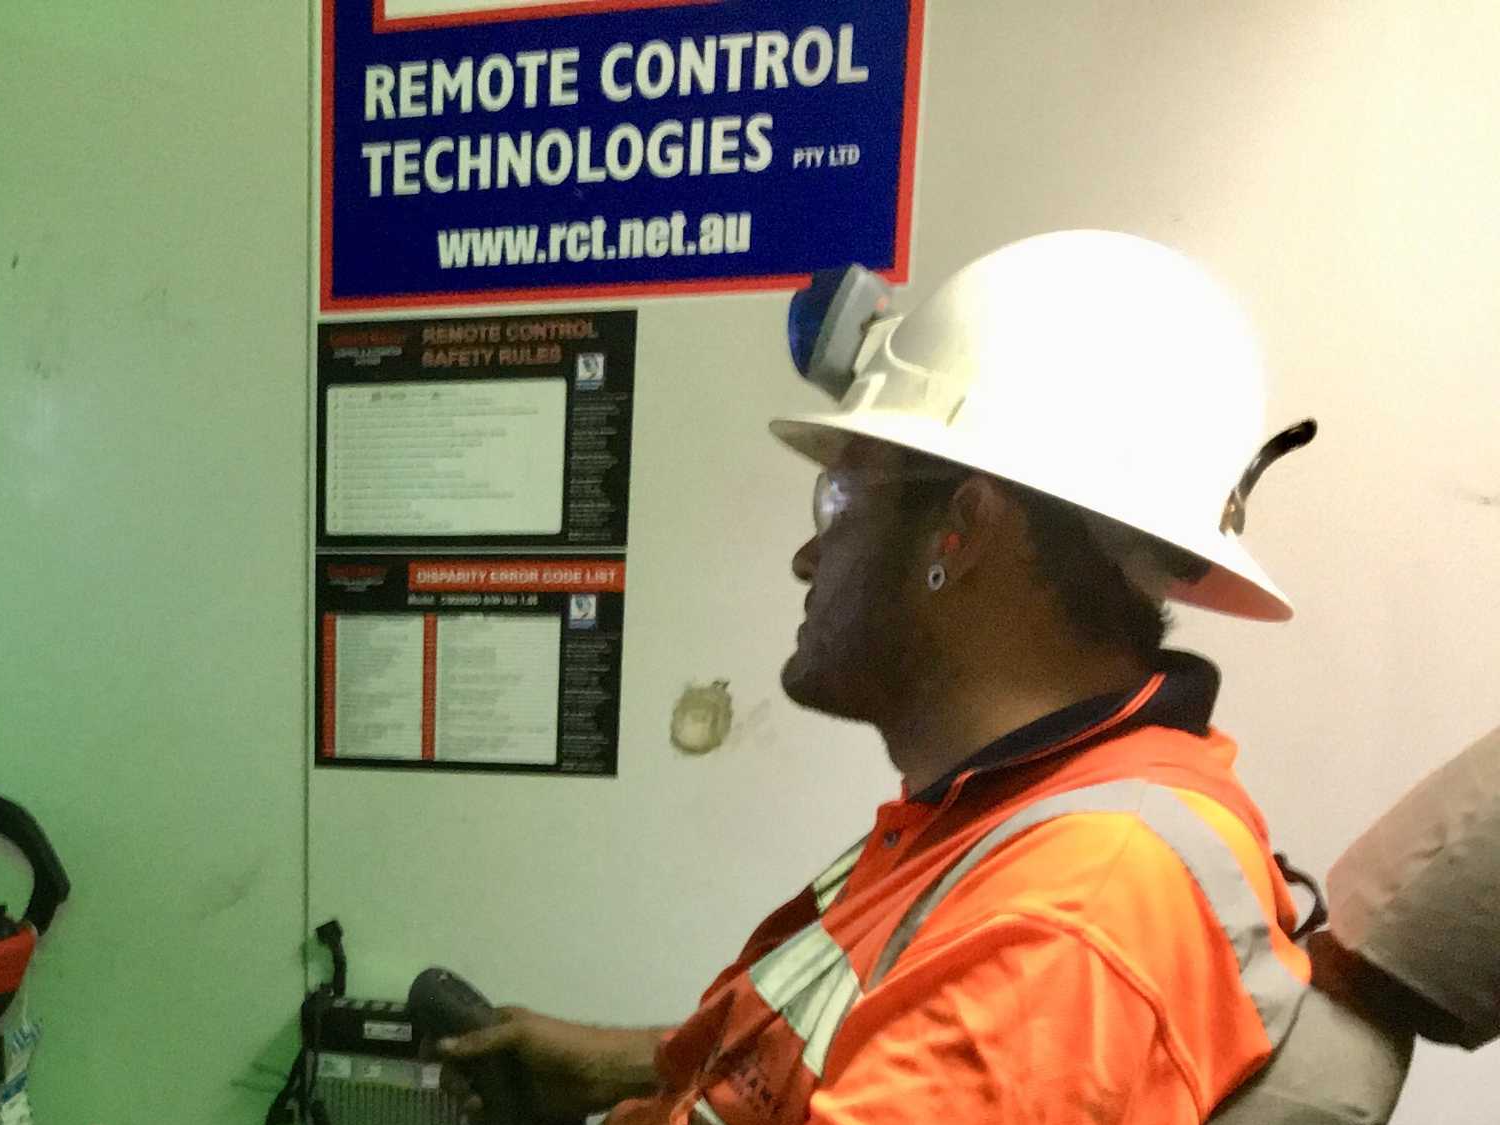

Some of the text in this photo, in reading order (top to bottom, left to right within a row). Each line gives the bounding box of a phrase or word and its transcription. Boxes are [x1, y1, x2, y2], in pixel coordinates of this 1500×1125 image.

[364, 23, 869, 121] REMOTE CONTROL
[362, 113, 861, 197] TECHNOLOGIES PTY LTD
[437, 210, 752, 269] www.rct.net.au
[422, 322, 500, 344] REMOTE
[506, 319, 598, 341] CONTROL
[421, 350, 493, 367] SAFETY
[499, 343, 563, 365] RULES
[542, 567, 582, 583] CODE
[586, 567, 616, 583] LIST
